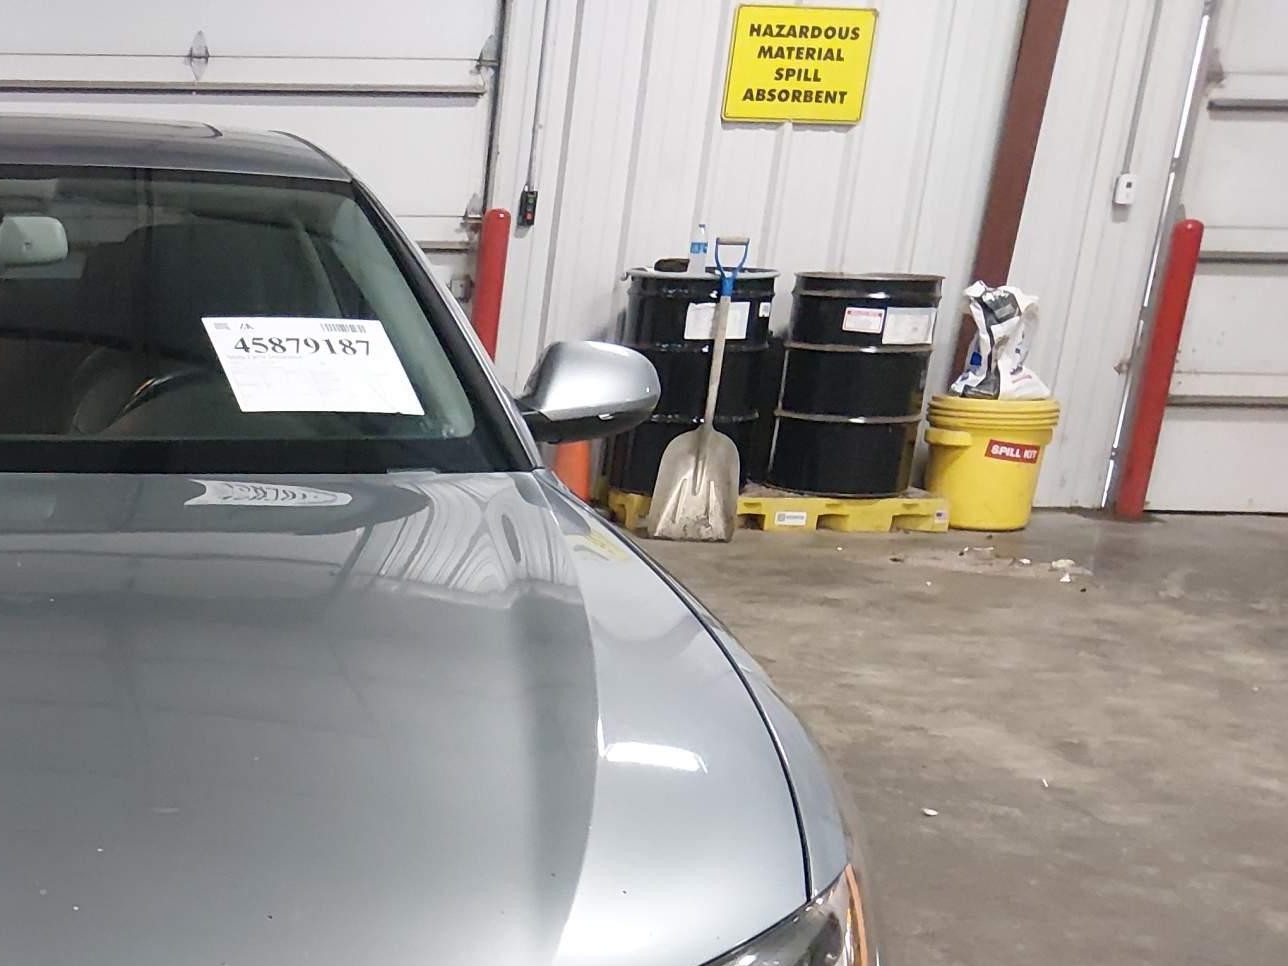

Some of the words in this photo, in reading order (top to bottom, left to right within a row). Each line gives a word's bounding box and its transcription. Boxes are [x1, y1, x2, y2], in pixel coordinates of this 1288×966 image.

[749, 23, 861, 40] HAZARDOUS
[757, 45, 845, 62] MATERIAL
[774, 67, 822, 82] SPILL
[743, 88, 848, 104] ABSORBENT
[234, 336, 370, 357] 45879187
[990, 444, 1021, 458] SPILL
[1023, 449, 1038, 460] KIT
